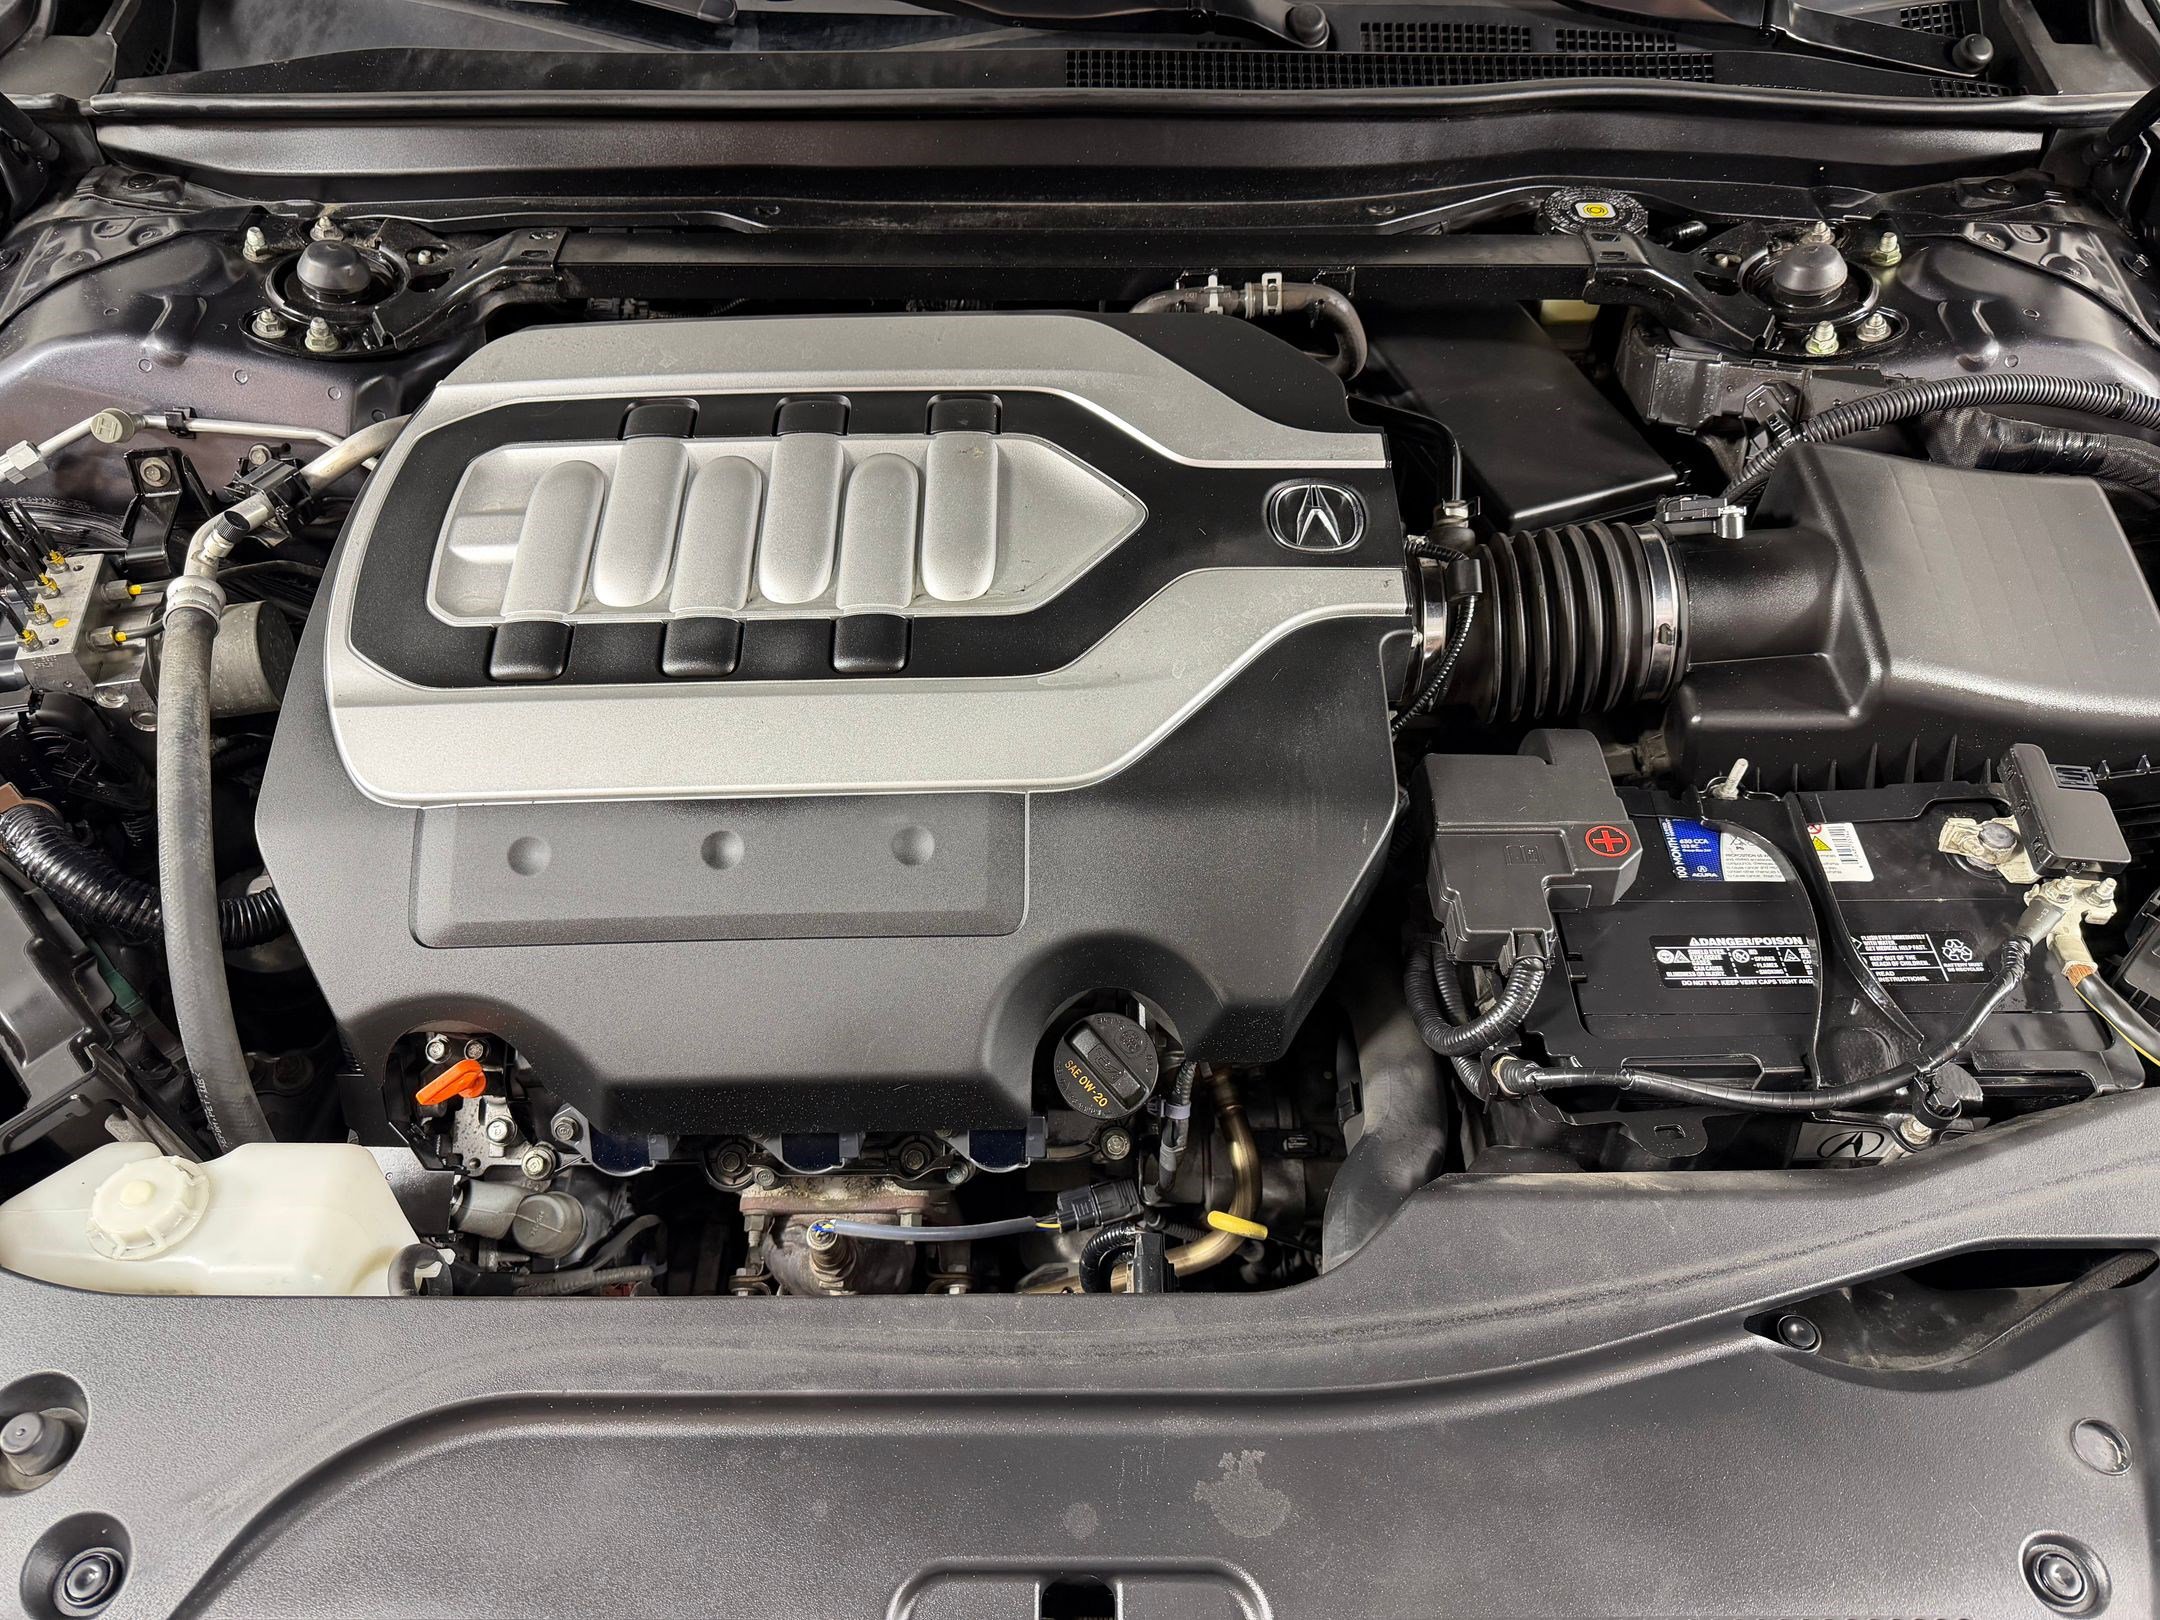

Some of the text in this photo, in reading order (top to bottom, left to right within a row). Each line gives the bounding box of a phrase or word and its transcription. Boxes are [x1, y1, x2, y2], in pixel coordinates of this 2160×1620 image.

[1666, 837, 1685, 865] MONTH
[1676, 866, 1689, 878] 100
[1698, 936, 1804, 946] DANGER/POISON
[1064, 1060, 1082, 1078] SAE
[1078, 1075, 1108, 1107] 0W-20
